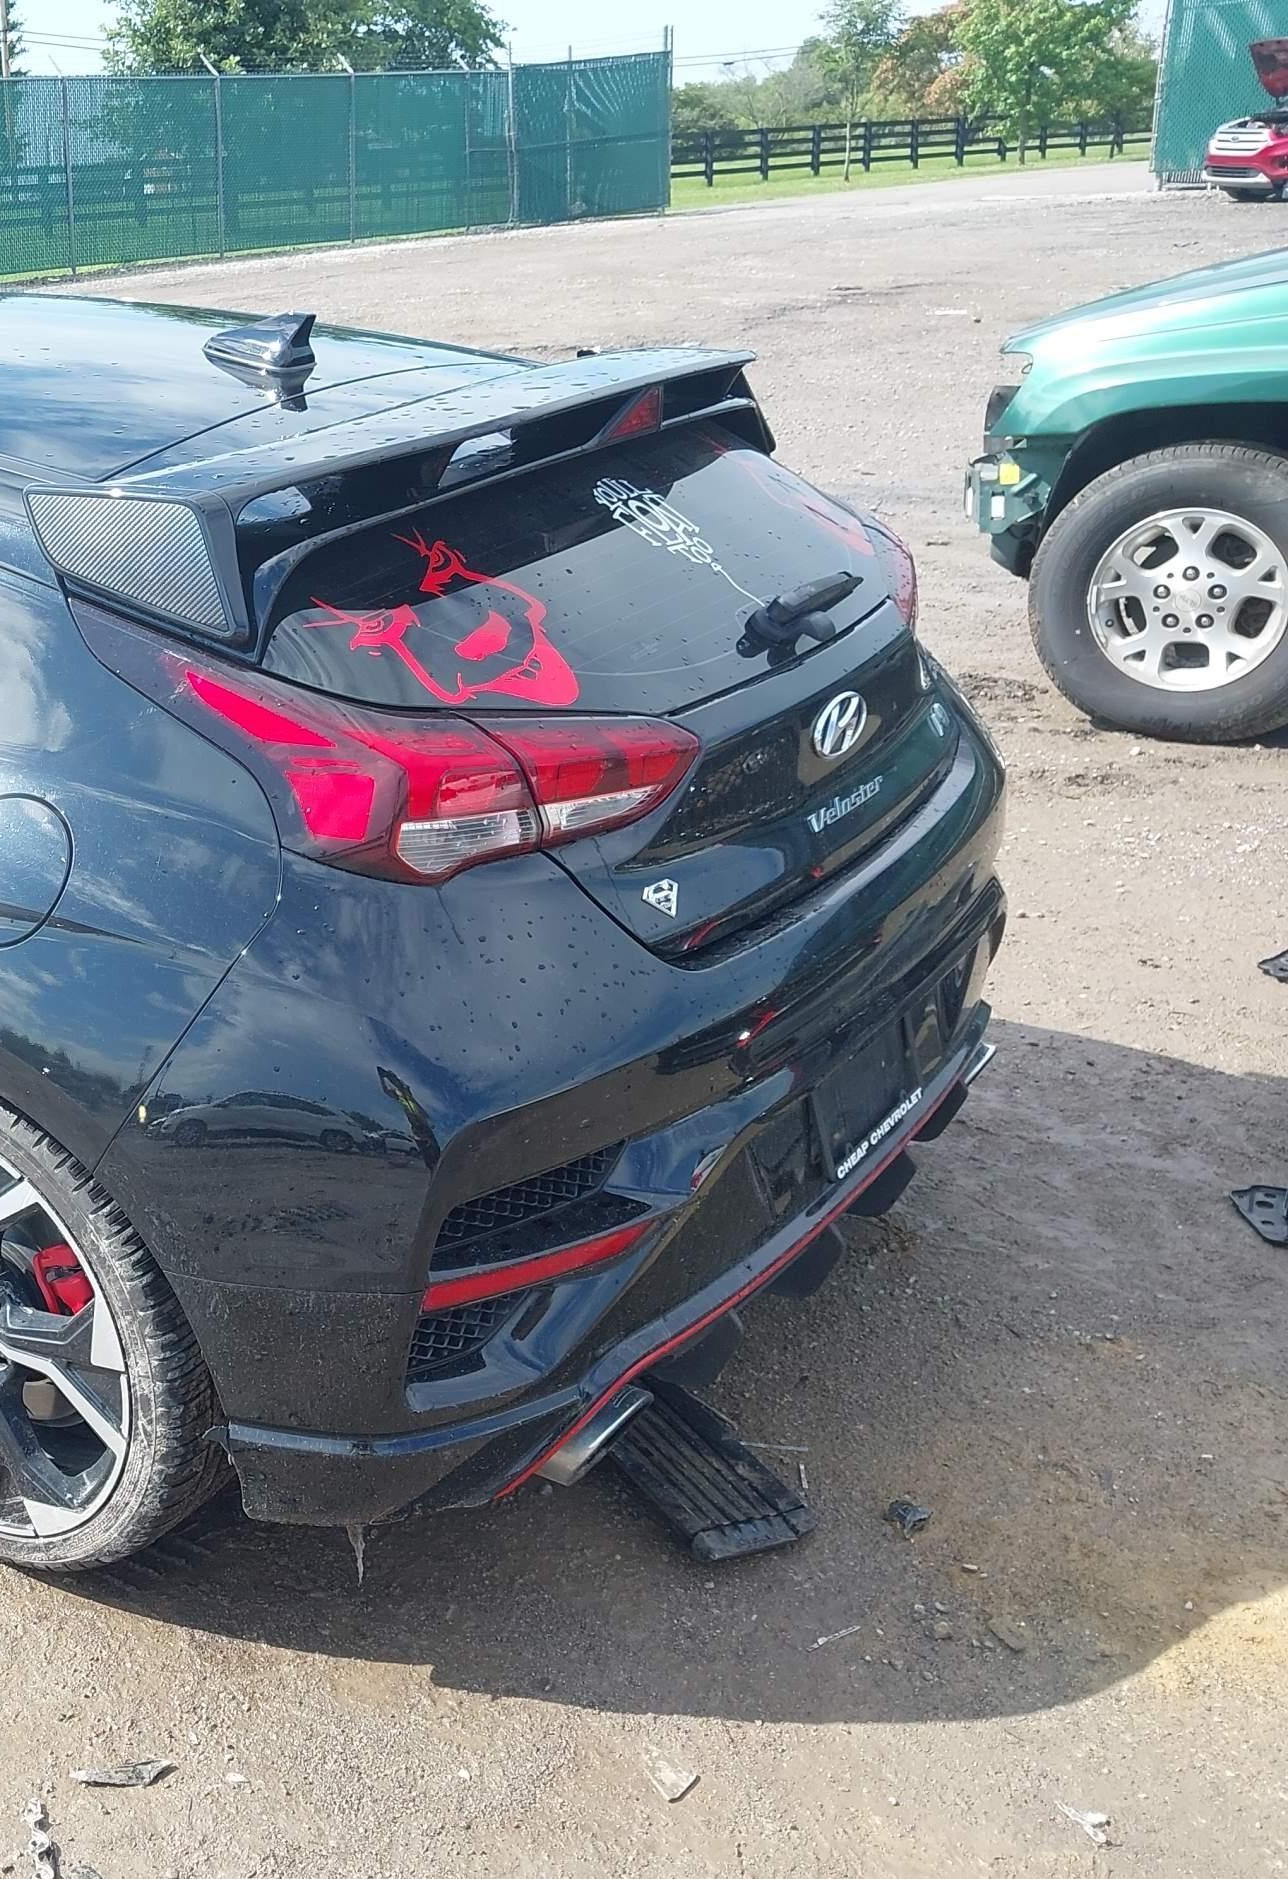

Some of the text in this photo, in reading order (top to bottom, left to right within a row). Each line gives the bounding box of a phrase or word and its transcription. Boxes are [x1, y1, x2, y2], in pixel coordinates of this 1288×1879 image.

[612, 494, 700, 547] FLOAT
[667, 537, 713, 564] TOO
[807, 776, 883, 833] Veloster
[837, 1088, 923, 1179] CHEAP CHEVROLET
